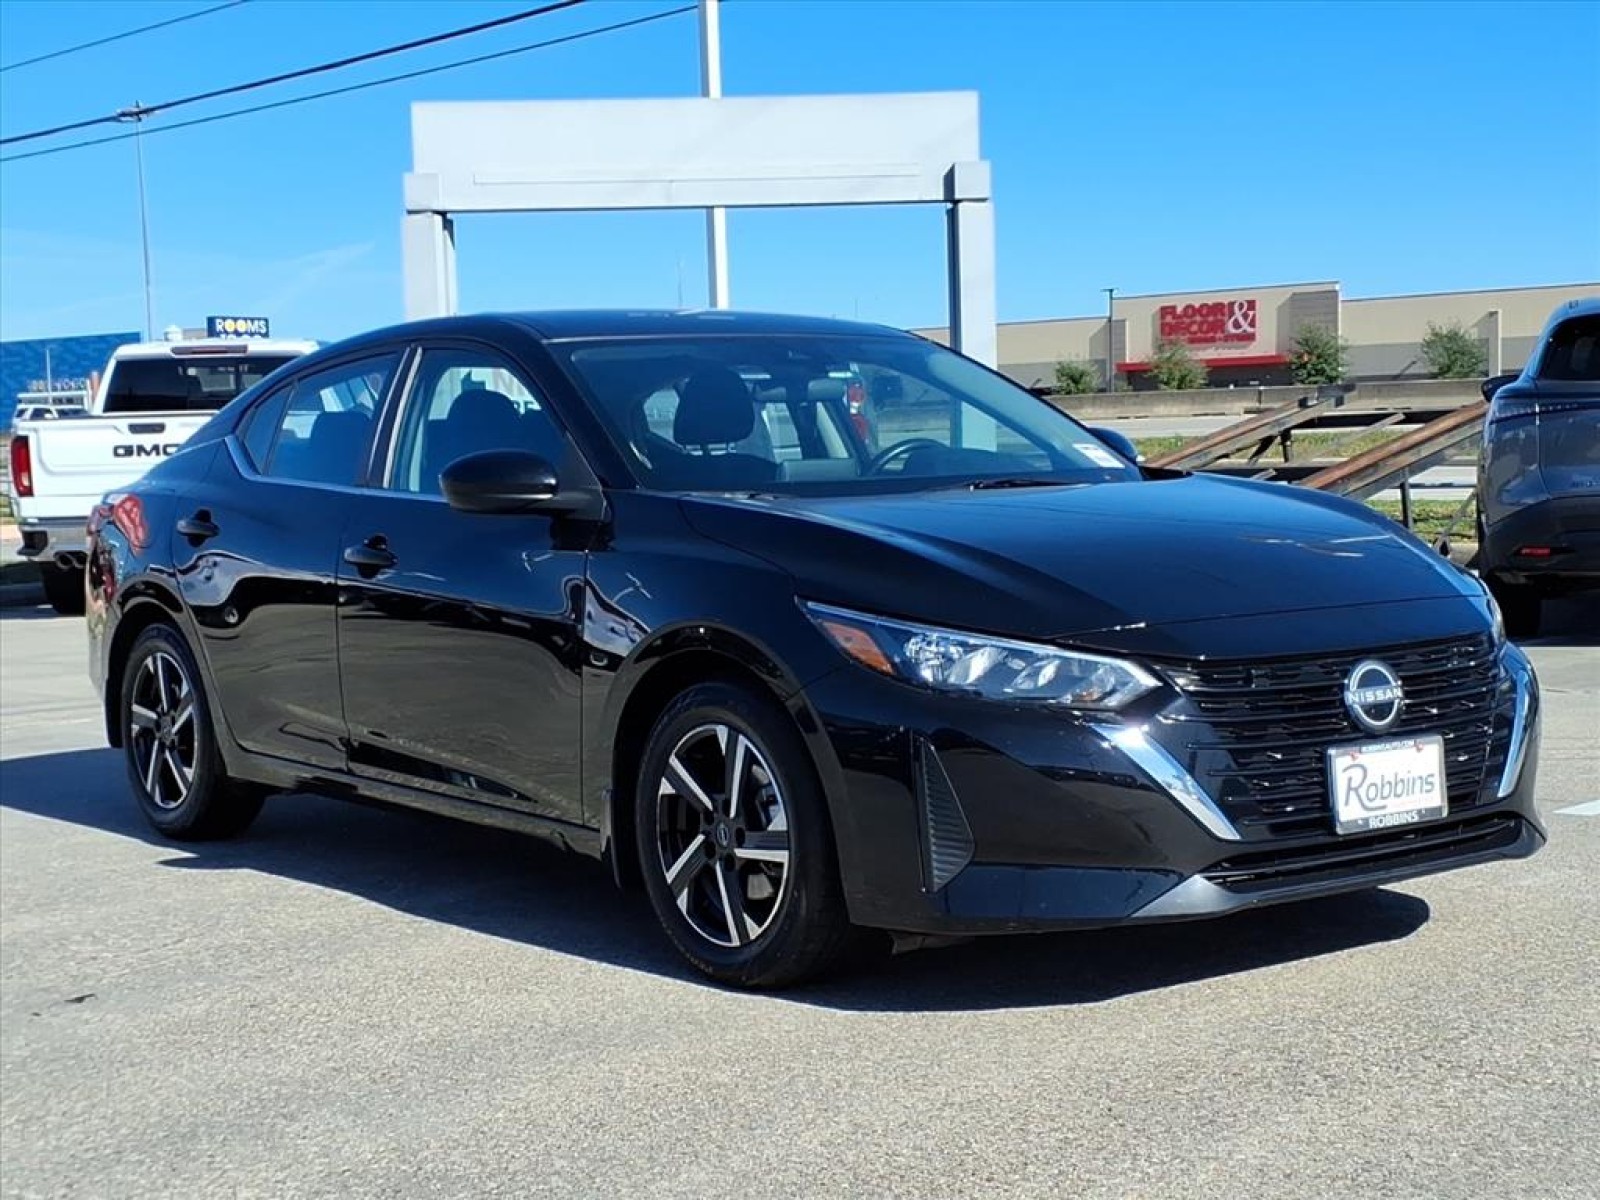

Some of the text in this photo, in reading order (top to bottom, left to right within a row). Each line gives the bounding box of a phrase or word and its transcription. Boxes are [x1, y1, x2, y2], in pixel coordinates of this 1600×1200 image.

[1160, 300, 1256, 334] FLOOR &
[215, 318, 267, 334] ROOMS
[1160, 319, 1225, 336] DECOR
[113, 443, 182, 457] GMC
[1348, 687, 1403, 704] NISSAN
[1342, 763, 1435, 811] Robbins
[1368, 810, 1419, 829] ROBBINS
